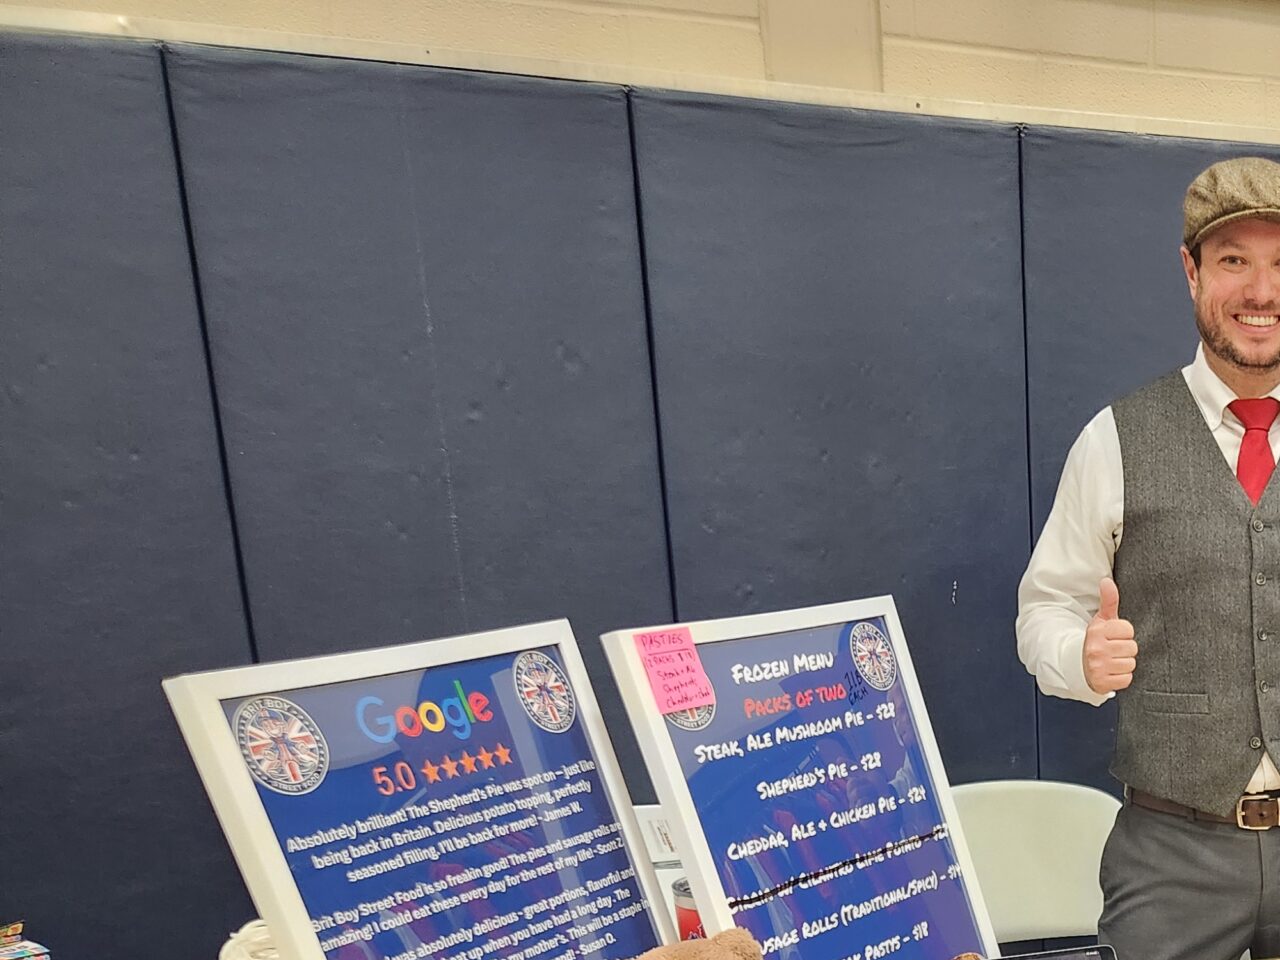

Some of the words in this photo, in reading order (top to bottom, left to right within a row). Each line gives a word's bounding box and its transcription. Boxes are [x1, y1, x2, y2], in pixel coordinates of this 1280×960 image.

[731, 660, 789, 684] FROZEN
[793, 652, 833, 673] MENU
[355, 680, 494, 743] Google
[744, 693, 793, 719] PACKS
[796, 690, 814, 708] OF
[817, 683, 847, 701] TWO
[693, 743, 745, 764] STEAK,
[747, 733, 773, 752] ALE
[775, 717, 843, 745] MUSHROOM
[844, 710, 865, 729] PIE
[372, 761, 416, 796] 5.0
[756, 767, 826, 800] SHEPHERD'S
[828, 762, 849, 781] PIE
[288, 825, 356, 851] Absolutely
[406, 805, 429, 818] The
[486, 784, 503, 797] Pie
[503, 781, 522, 792] was
[312, 850, 352, 868] being
[349, 840, 380, 857] back
[434, 813, 483, 833] Delicious
[483, 803, 516, 821] potato
[554, 780, 590, 801] perfectly
[791, 822, 817, 842] ALE
[829, 802, 876, 829] CHICKEN
[877, 795, 898, 814] PIE
[347, 855, 404, 881] seasoned
[468, 828, 495, 844] back
[334, 909, 359, 924] Boy
[359, 896, 396, 915] Street
[395, 884, 424, 903] Food
[447, 868, 482, 886] freakin
[381, 911, 412, 930] could
[431, 897, 460, 912] these
[461, 887, 487, 902] every
[418, 929, 472, 956] absolutely
[473, 913, 518, 935] delicious
[523, 900, 549, 919] great
[587, 871, 621, 891] flavorful
[483, 937, 511, 953] when
[529, 920, 553, 935] have
[577, 902, 598, 915] long
[579, 939, 606, 955] Susan
[761, 928, 800, 956] USAGE
[802, 912, 839, 939] ROLLS
